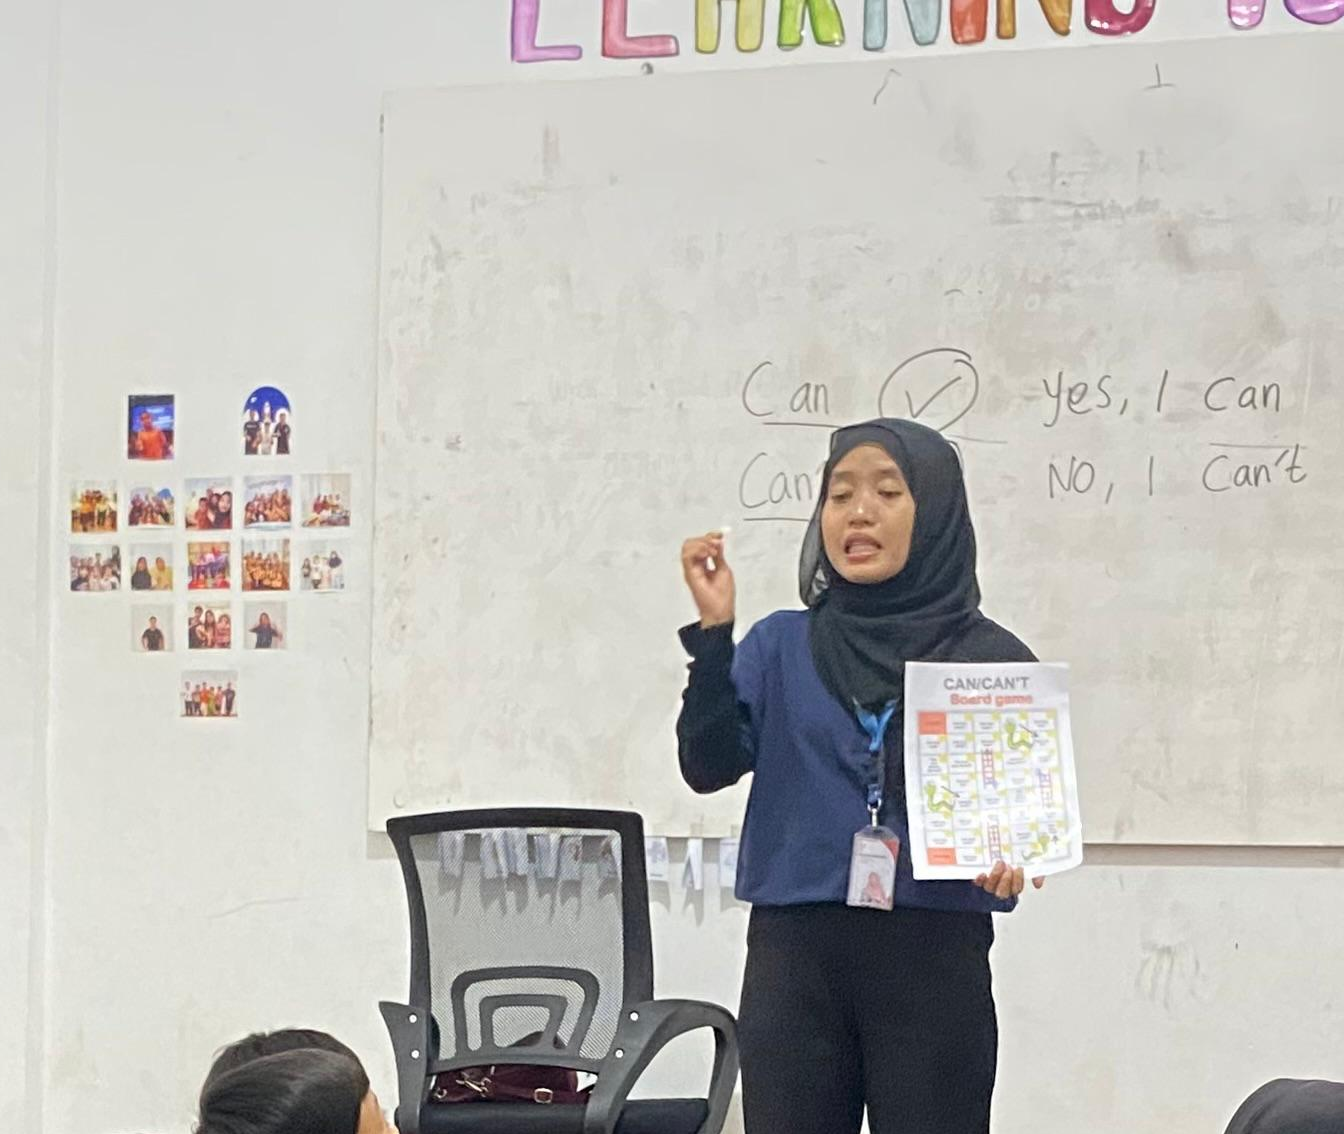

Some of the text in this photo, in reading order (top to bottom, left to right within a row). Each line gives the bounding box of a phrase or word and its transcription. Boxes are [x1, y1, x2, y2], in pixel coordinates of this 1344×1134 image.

[742, 361, 830, 417] Can
[1203, 376, 1281, 413] Can
[739, 451, 826, 509] Can'
[1202, 443, 1307, 492] Can't
[943, 676, 1031, 691] CAN/CAN'T
[950, 693, 1034, 708] Board game
